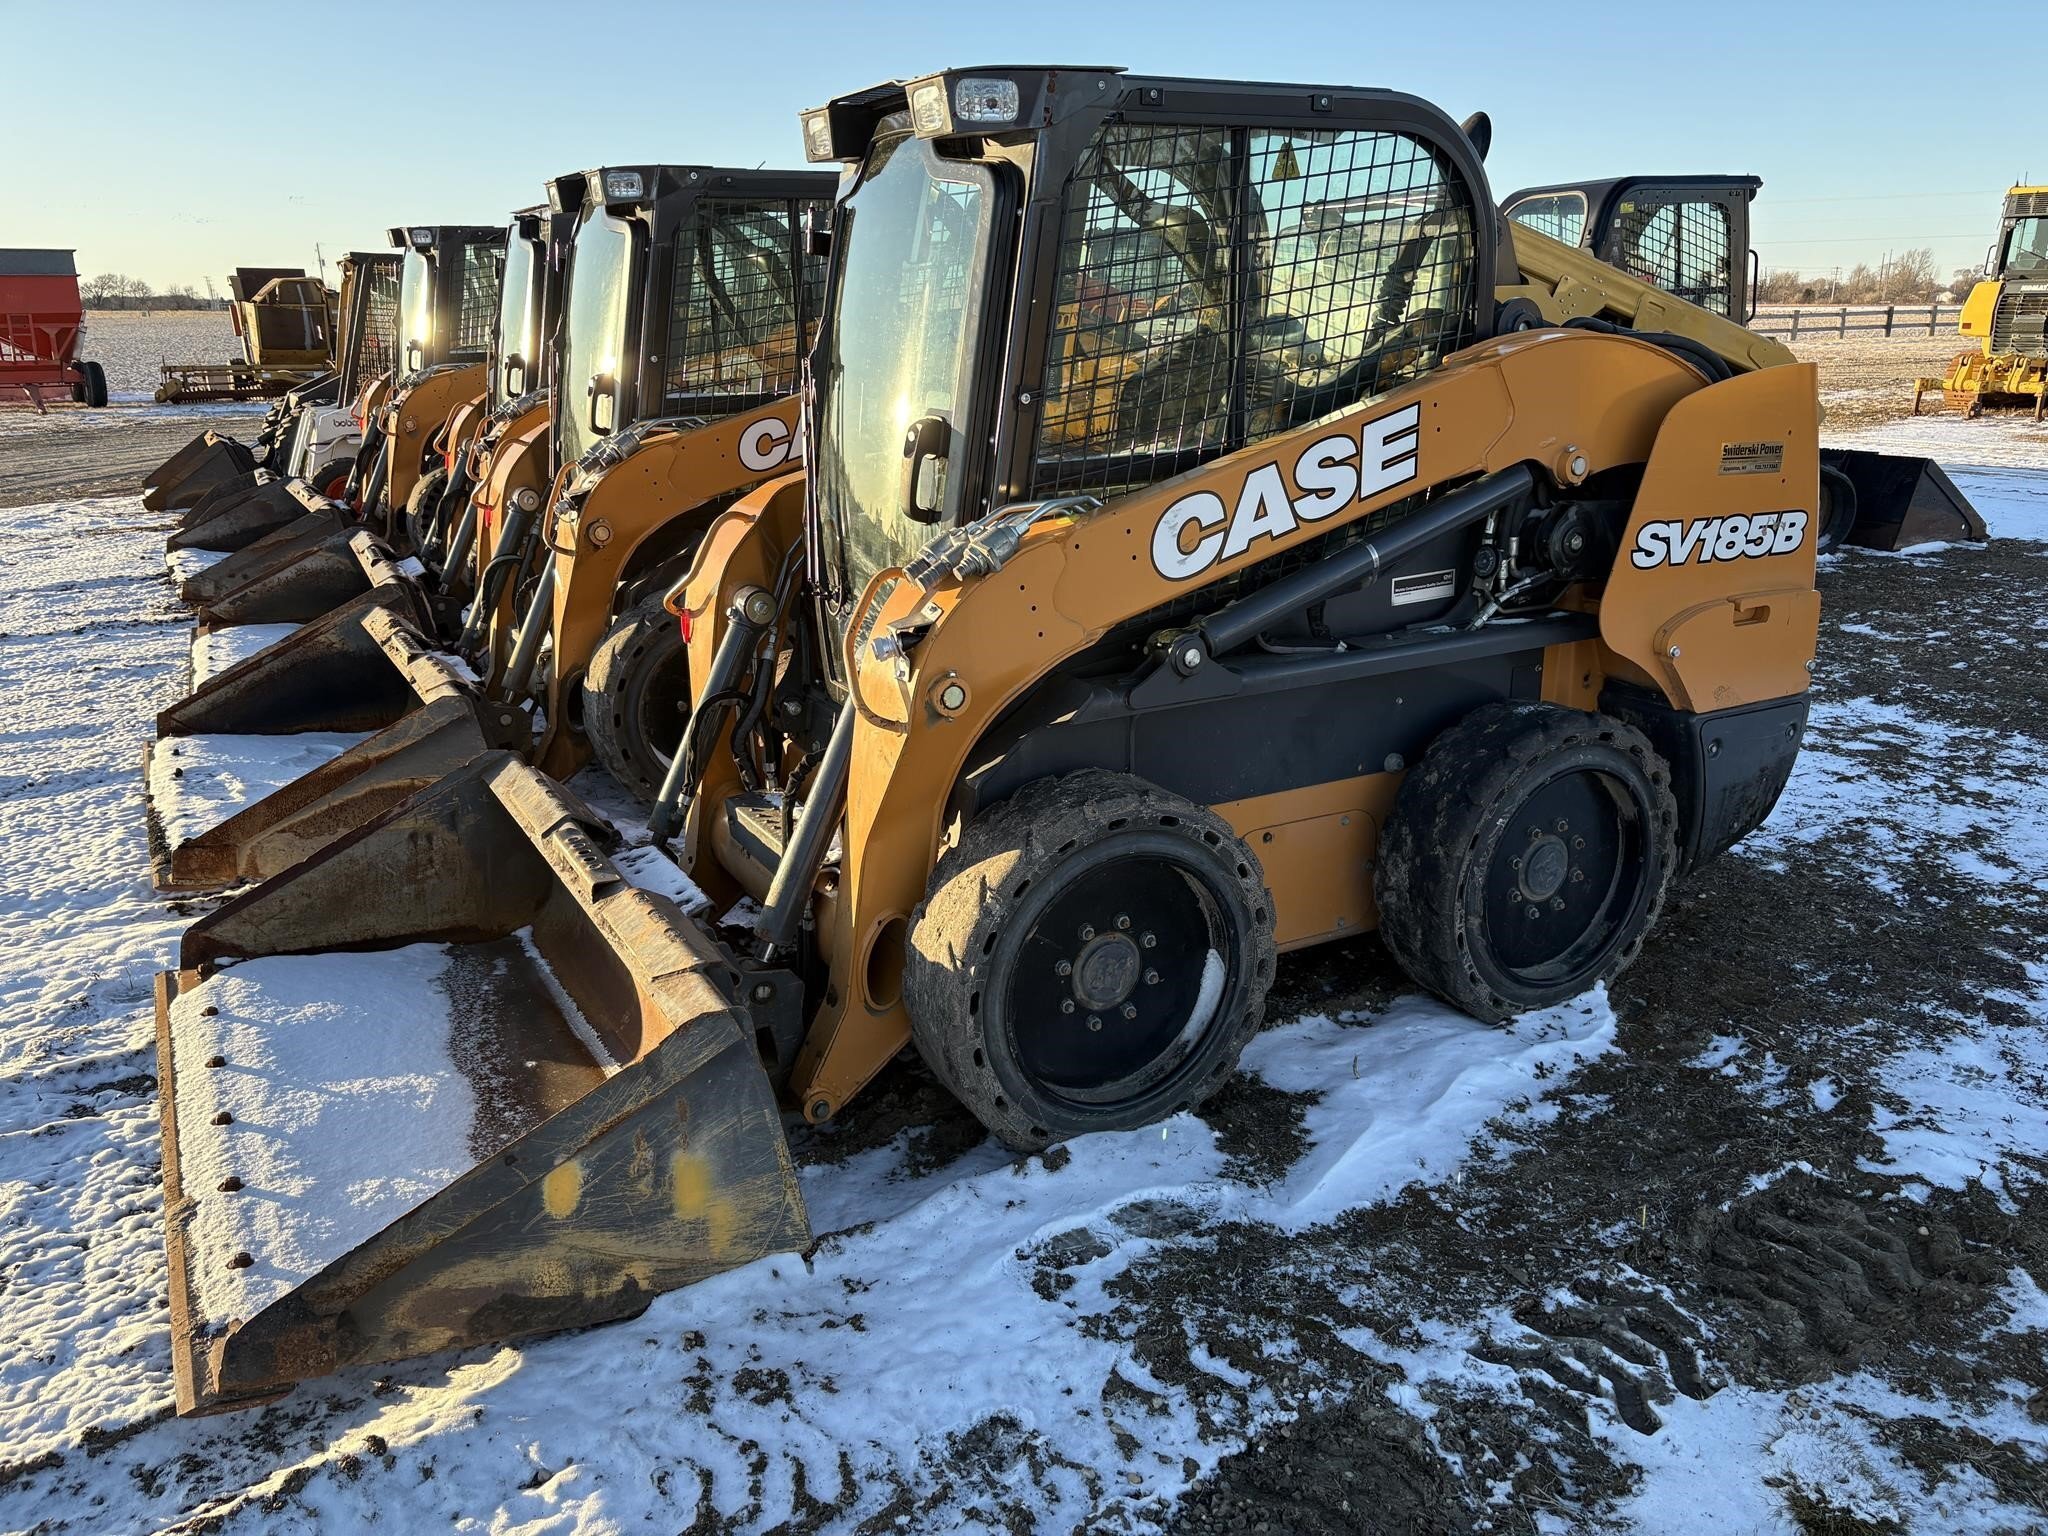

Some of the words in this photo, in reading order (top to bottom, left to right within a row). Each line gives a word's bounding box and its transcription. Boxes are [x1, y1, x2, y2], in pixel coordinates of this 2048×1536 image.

[1722, 443, 1759, 456] Swiderski
[1759, 443, 1783, 455] Power
[1151, 400, 1421, 582] CASE
[1631, 509, 1808, 570] SV185B
